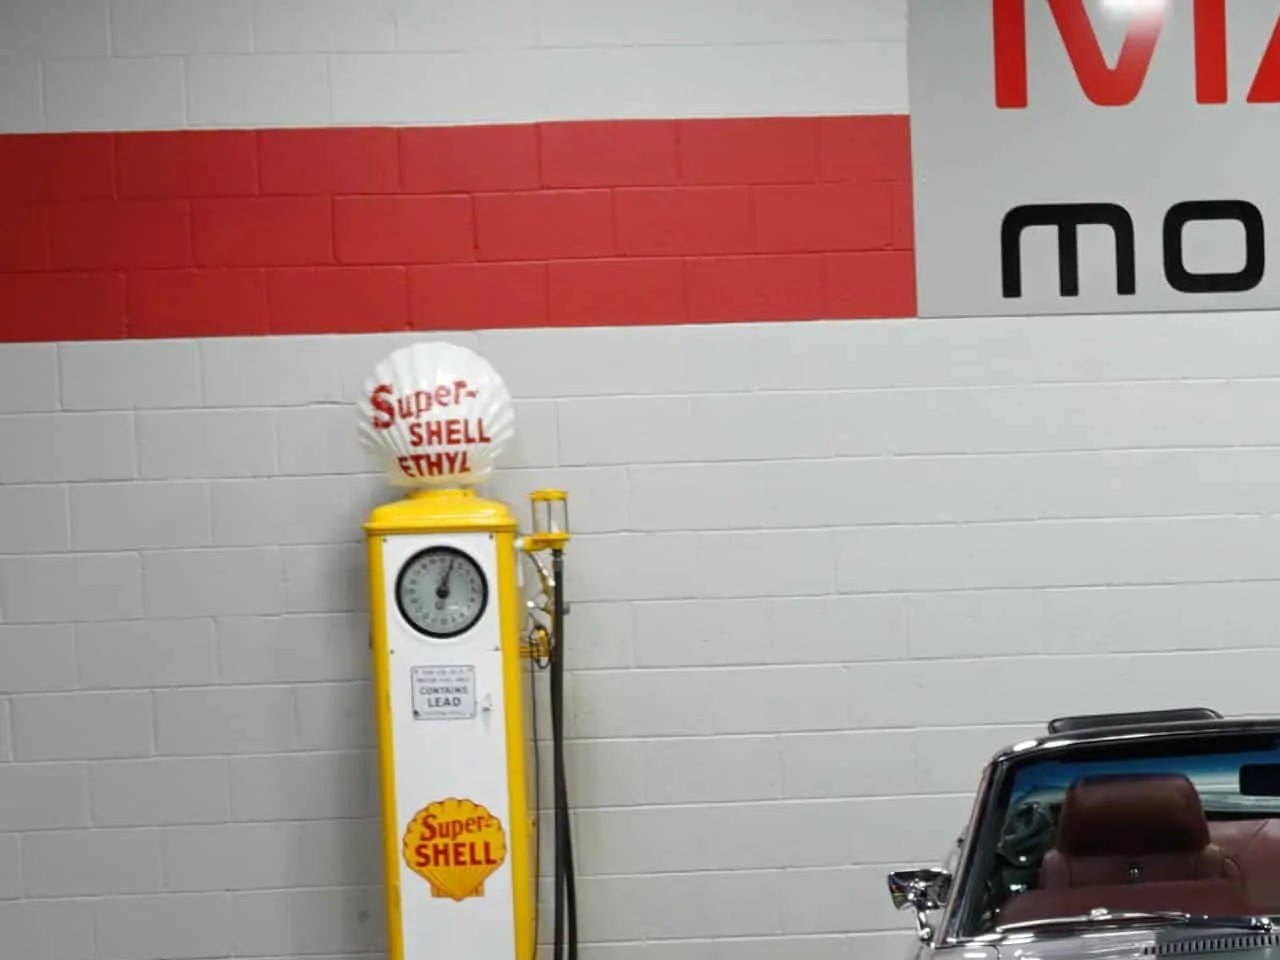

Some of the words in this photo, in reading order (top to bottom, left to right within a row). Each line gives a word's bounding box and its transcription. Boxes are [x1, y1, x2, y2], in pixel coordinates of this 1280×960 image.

[370, 380, 480, 430] Super-
[409, 418, 492, 447] SHELL
[397, 450, 471, 478] ETHYL
[419, 686, 468, 696] CONTAINS
[427, 696, 462, 708] LEAD
[414, 841, 497, 867] SHELL
